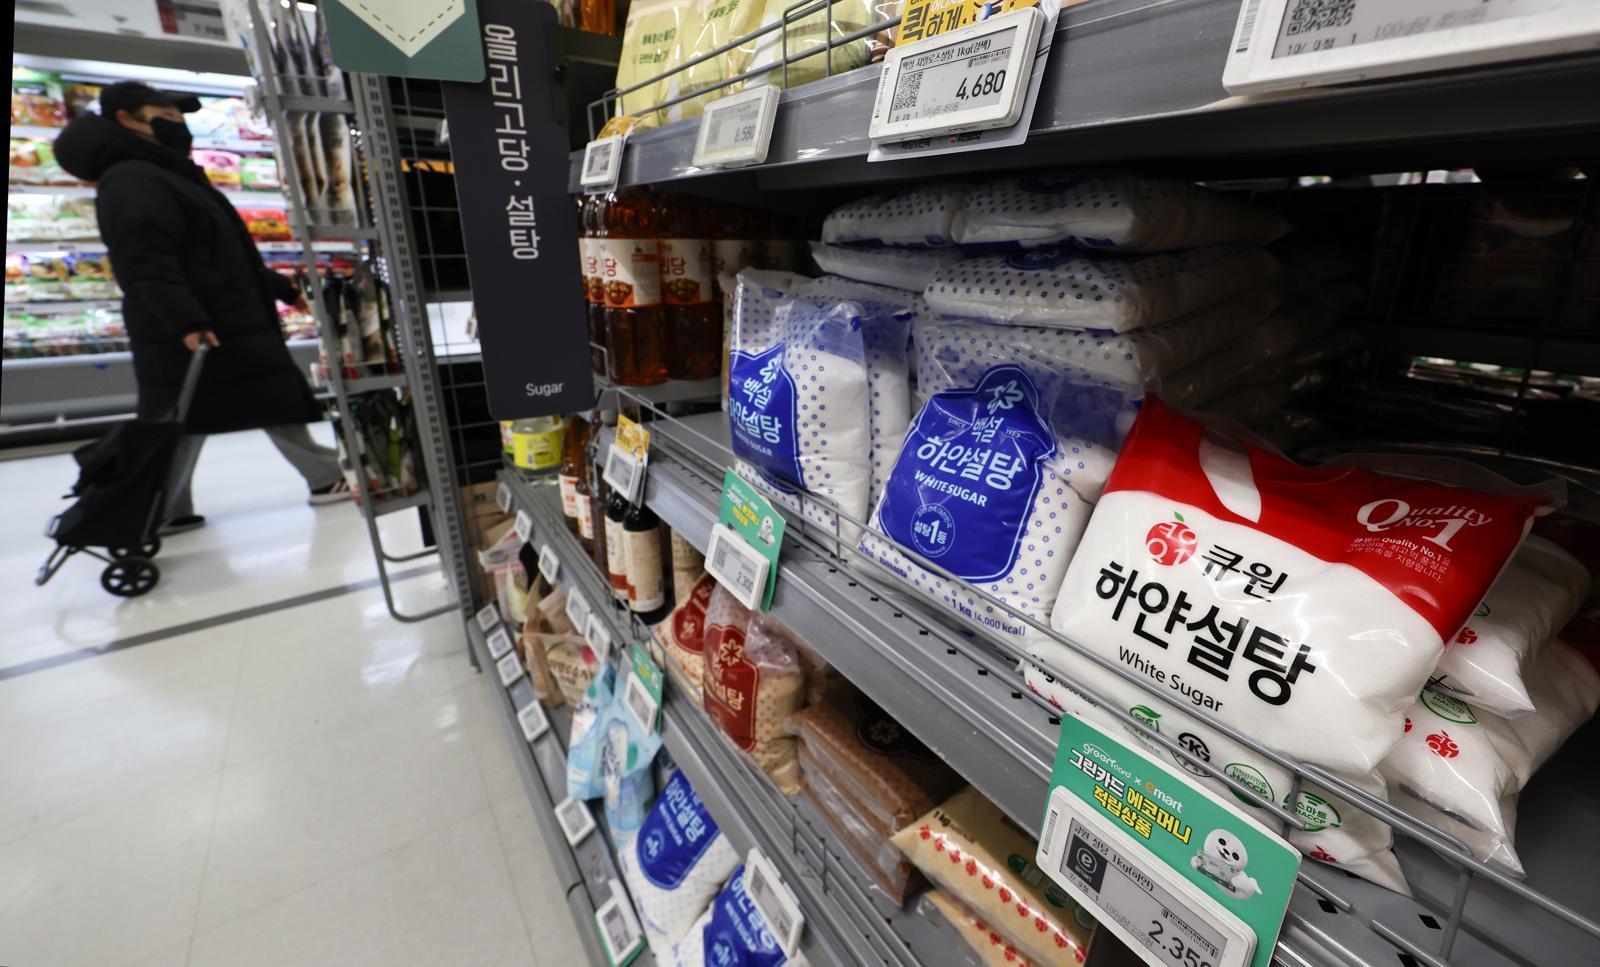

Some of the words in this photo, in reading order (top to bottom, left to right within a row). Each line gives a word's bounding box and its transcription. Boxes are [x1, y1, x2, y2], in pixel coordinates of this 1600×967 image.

[484, 24, 530, 172] 올리고당
[955, 69, 1007, 101] 4,680
[505, 195, 540, 259] 설탕
[525, 382, 565, 397] Sugar
[742, 376, 773, 411] 백설
[971, 415, 1004, 443] 백설
[916, 435, 1024, 491] 하얀설탕
[945, 483, 989, 508] SUGAR
[1356, 498, 1493, 533] Quality
[1381, 537, 1419, 551] Quality
[1201, 544, 1289, 603] 큐원
[1095, 560, 1317, 706] 하얀설탕
[1119, 645, 1167, 684] White
[1169, 674, 1224, 713] Sugar
[1068, 748, 1126, 799] 그린카드
[1126, 787, 1192, 845] 에코머니
[1093, 784, 1153, 840] 적립상품
[1144, 781, 1184, 813] emart
